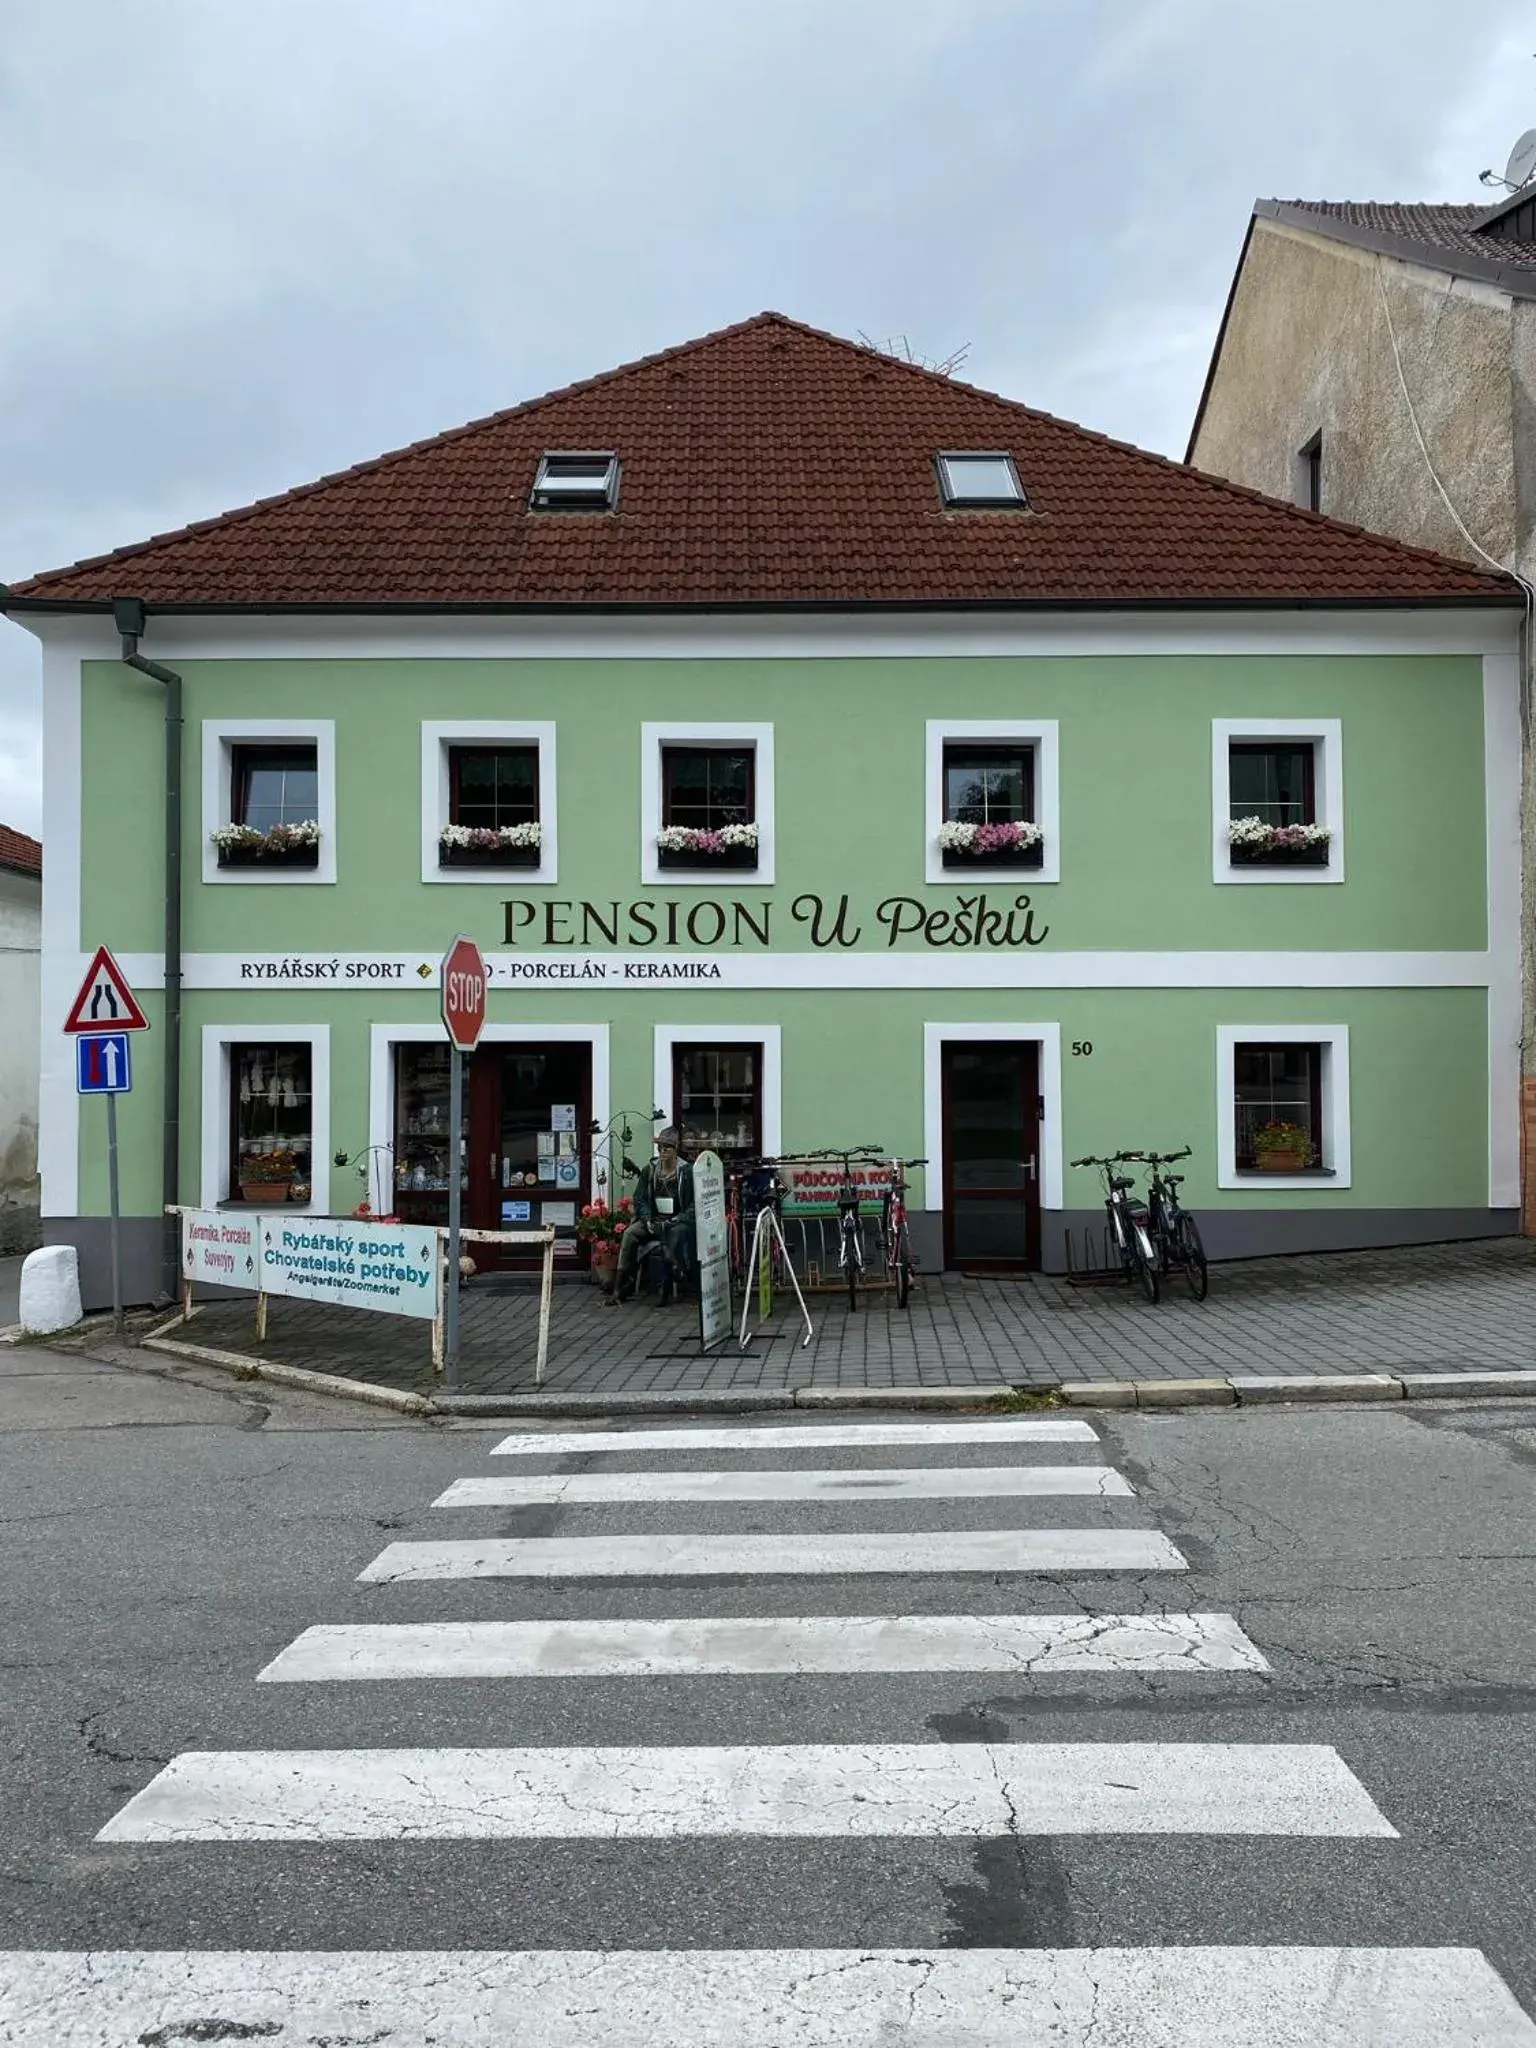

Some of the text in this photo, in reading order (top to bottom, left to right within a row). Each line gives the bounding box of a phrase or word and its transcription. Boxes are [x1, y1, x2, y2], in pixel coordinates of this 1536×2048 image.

[500, 894, 1050, 948] PENSION U Pešků
[240, 958, 341, 979] RYBÁŘSKÝ
[345, 963, 406, 979] SPORT
[510, 959, 606, 979] PORCELÁN
[623, 963, 722, 979] KERAMIKA
[448, 970, 483, 1014] STOP
[1071, 1041, 1093, 1056] 50
[282, 1231, 405, 1259] Rybářský sport
[264, 1249, 431, 1288] Chovatelské potřeby
